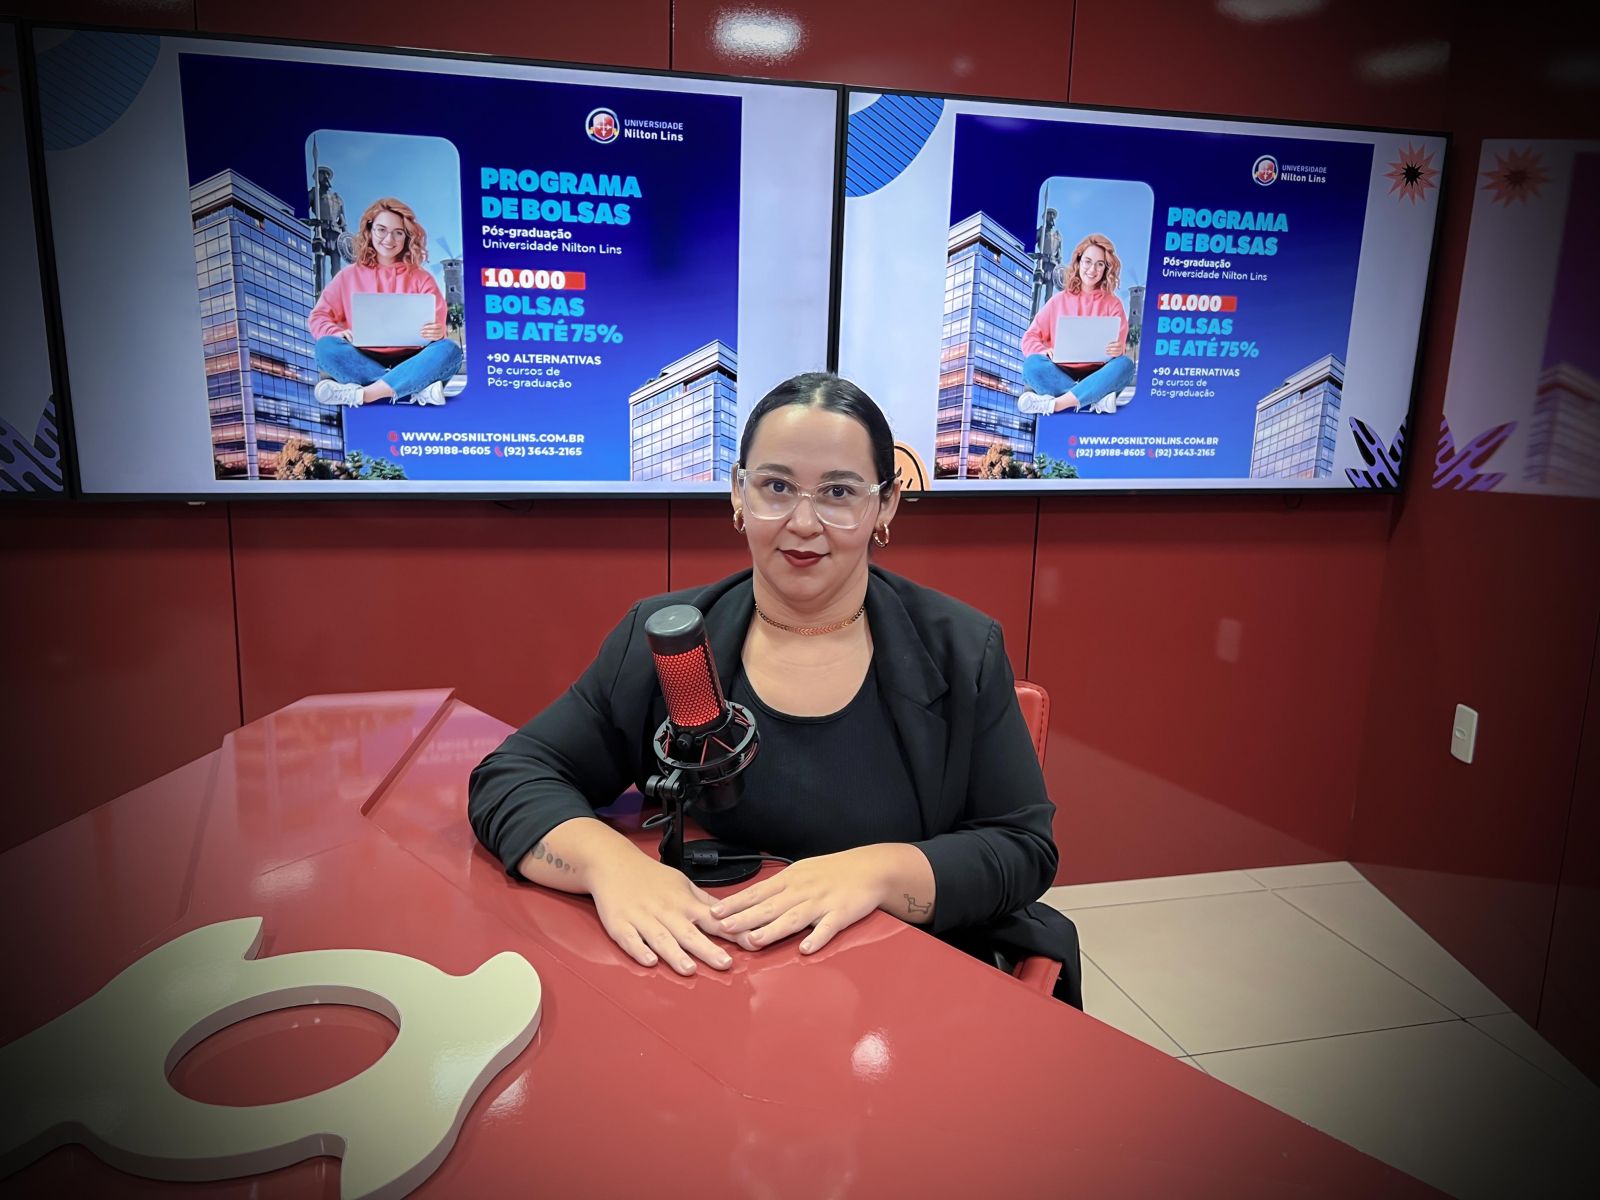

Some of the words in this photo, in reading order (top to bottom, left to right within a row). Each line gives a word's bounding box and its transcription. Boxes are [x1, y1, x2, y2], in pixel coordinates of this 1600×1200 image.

[624, 119, 683, 130] UNIVERSIDADE
[624, 130, 658, 140] Nilton
[660, 131, 683, 141] Lins
[1282, 165, 1327, 173] UNIVERSIDADE
[481, 167, 642, 198] PROGRAMA
[1281, 173, 1306, 182] Nilton
[1308, 174, 1326, 183] Lins
[482, 197, 522, 220] DE
[522, 199, 631, 225] BOLSAS
[1167, 207, 1289, 232] PROGRAMA
[482, 225, 572, 241] Pós-graduação
[482, 239, 558, 252] Universidade
[562, 242, 596, 253] Nilton
[599, 244, 622, 254] Lins
[1165, 232, 1193, 252] DE
[1195, 234, 1278, 256] BOLSAS
[1163, 257, 1231, 269] Pós-graduação
[485, 268, 566, 290] 10.000
[1162, 269, 1220, 279] Universidade
[1222, 271, 1247, 280] Nilton
[1250, 272, 1267, 281] Lins
[485, 295, 584, 317] BOLSAS
[1160, 294, 1221, 311] 10.000
[486, 320, 520, 340] DE
[522, 318, 568, 342] ATÉ
[572, 324, 624, 343] 75%
[1157, 317, 1233, 335] BOLSAS
[1155, 339, 1183, 356] DE
[1183, 337, 1218, 357] ATÉ
[1220, 341, 1260, 357] 75%
[487, 354, 510, 363] +90
[514, 354, 602, 365] ALTERNATIVAS
[488, 366, 504, 375] De
[506, 368, 542, 376] cursos
[546, 366, 560, 376] de
[1153, 367, 1171, 376] +90
[1173, 367, 1240, 377] ALTERNATIVAS
[488, 378, 572, 389] Pós-graduação
[1152, 378, 1164, 386] De
[1196, 379, 1207, 387] de
[1151, 389, 1215, 398] Pós-graduação
[402, 432, 585, 443] WWW.POSNILTONLINS.COM.BR
[1079, 437, 1219, 445] WWW.POSNILTONLINS.COM.BR
[400, 445, 423, 456] (92)
[425, 446, 491, 455] 99188-8605
[504, 446, 525, 457] (92)
[528, 447, 582, 456] 3643-2165
[1076, 448, 1093, 458] (92)
[1095, 449, 1145, 457] 99188-8605
[1155, 449, 1172, 458] (92)
